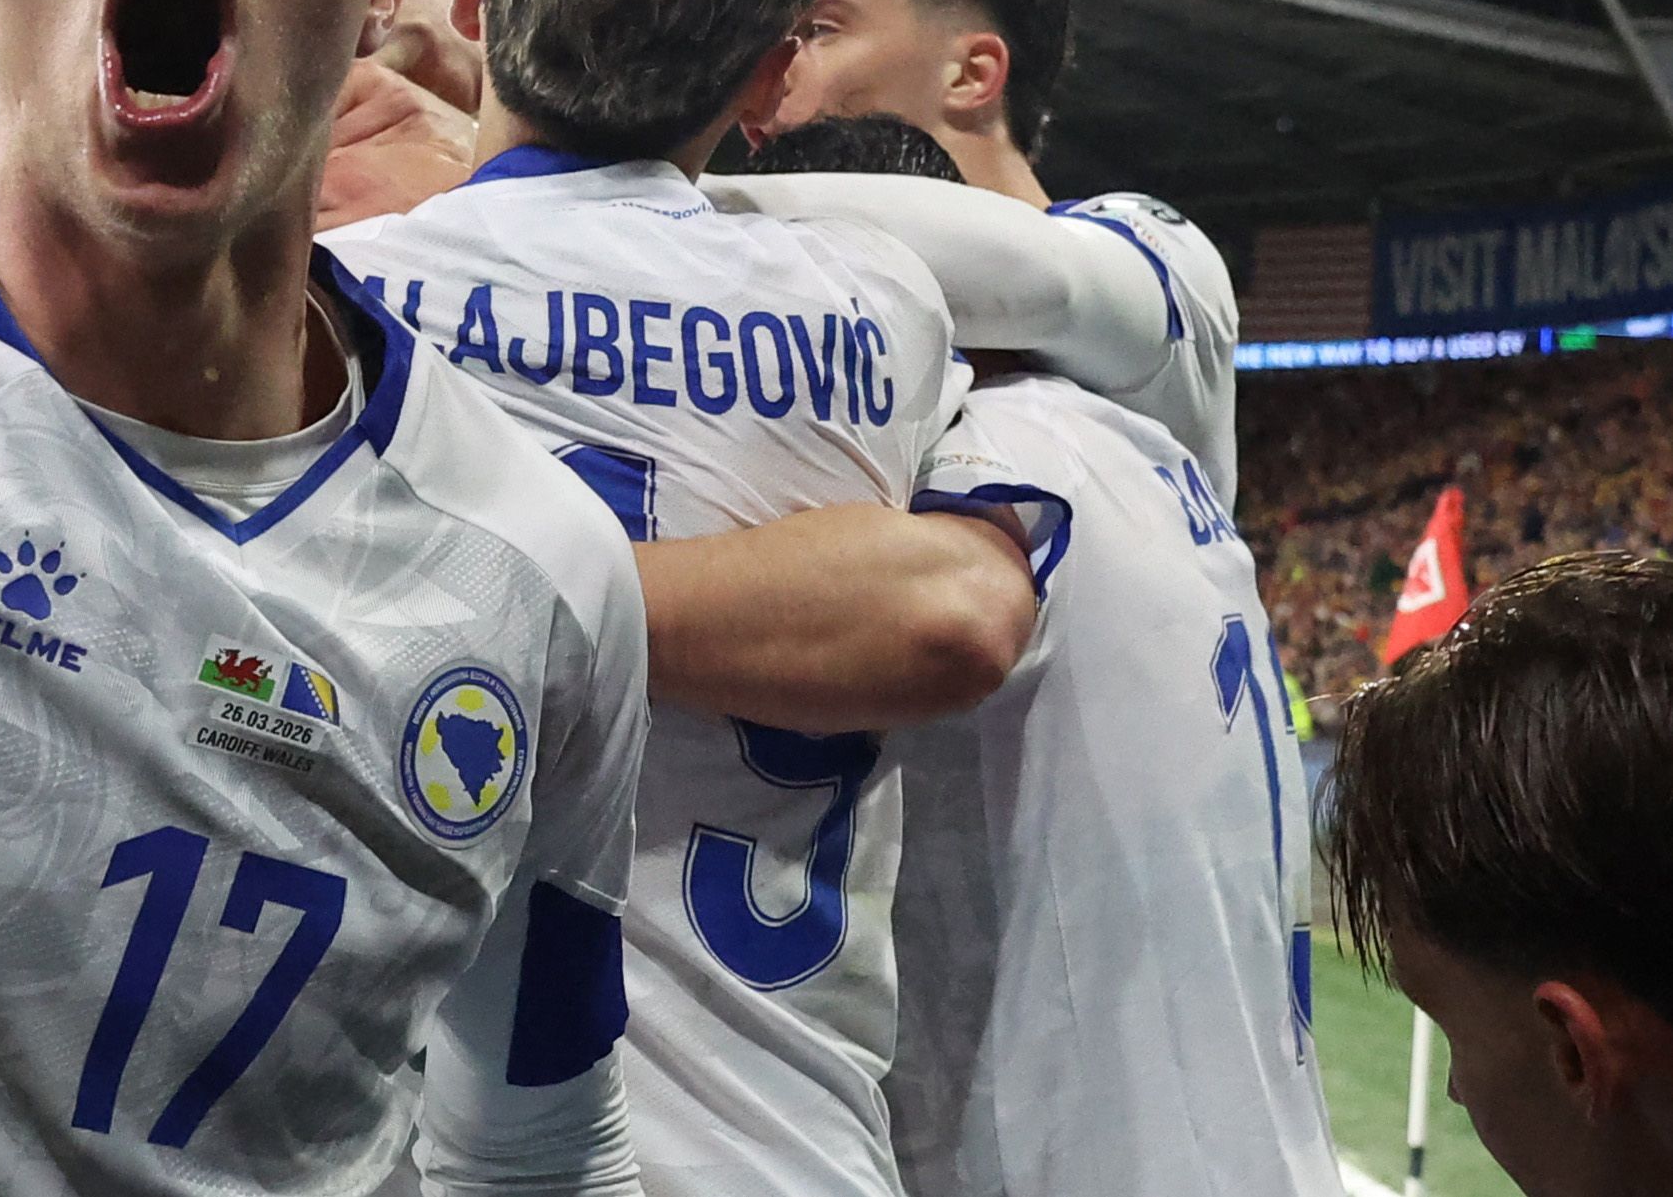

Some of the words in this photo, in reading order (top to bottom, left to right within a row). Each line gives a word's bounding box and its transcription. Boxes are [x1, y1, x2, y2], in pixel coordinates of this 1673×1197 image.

[1391, 230, 1505, 316] VISIT
[364, 275, 894, 427] LAJBEGOVIĆ
[220, 703, 315, 745] 26.03.2026
[263, 744, 315, 773] WALES
[71, 824, 348, 1150] 17
